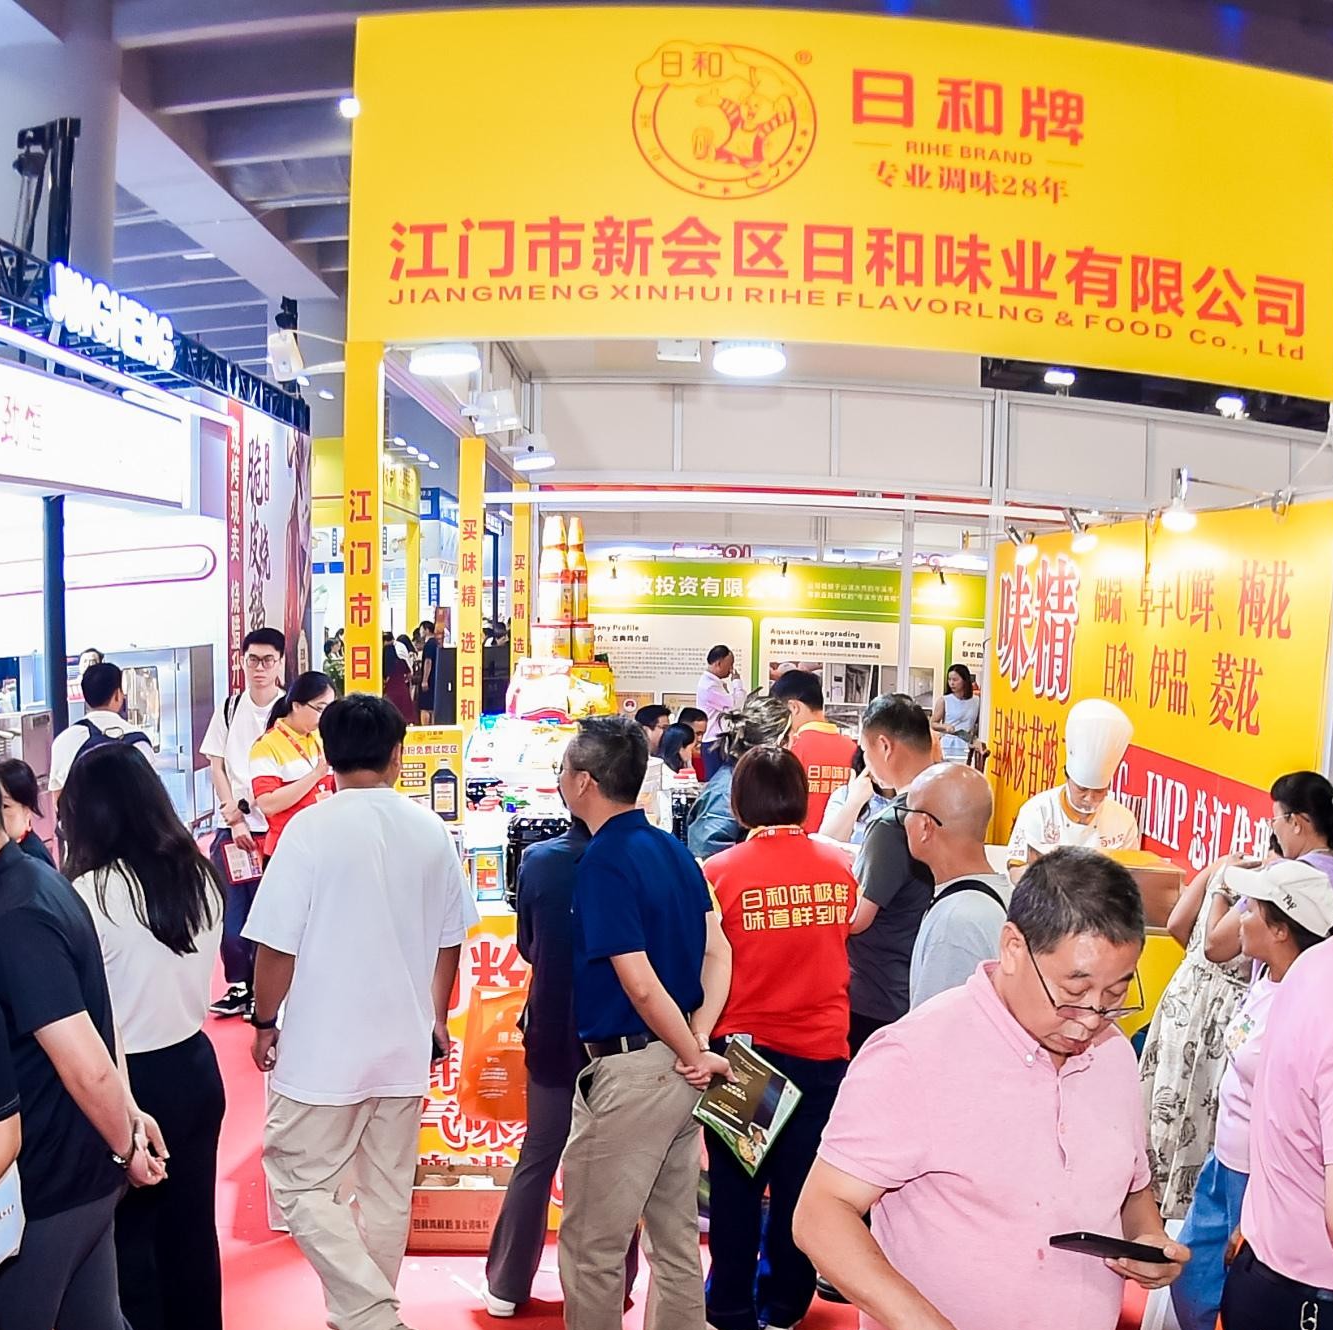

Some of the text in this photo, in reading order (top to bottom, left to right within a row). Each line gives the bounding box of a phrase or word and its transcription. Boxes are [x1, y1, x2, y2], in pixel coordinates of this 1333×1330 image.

[661, 51, 722, 77] 日和
[852, 67, 1085, 146] 日和牌
[906, 141, 1033, 166] RIHE BRAND
[875, 160, 1069, 204] 专业调味28年
[389, 216, 1305, 338] 江门市新会区日和味业有限公司
[388, 284, 599, 306] JIANGMENG
[609, 284, 733, 303] XINHUI
[744, 286, 825, 307] RIHE
[837, 290, 1044, 325] FLAVORLNG
[1055, 310, 1074, 327] &
[1085, 312, 1173, 340] FOOD
[349, 489, 372, 680] 江门市日
[460, 519, 477, 720] 买味精 选日和
[770, 628, 818, 638] Aquaculture
[996, 556, 1080, 703] 味精
[741, 883, 850, 910] 日和味极鲜
